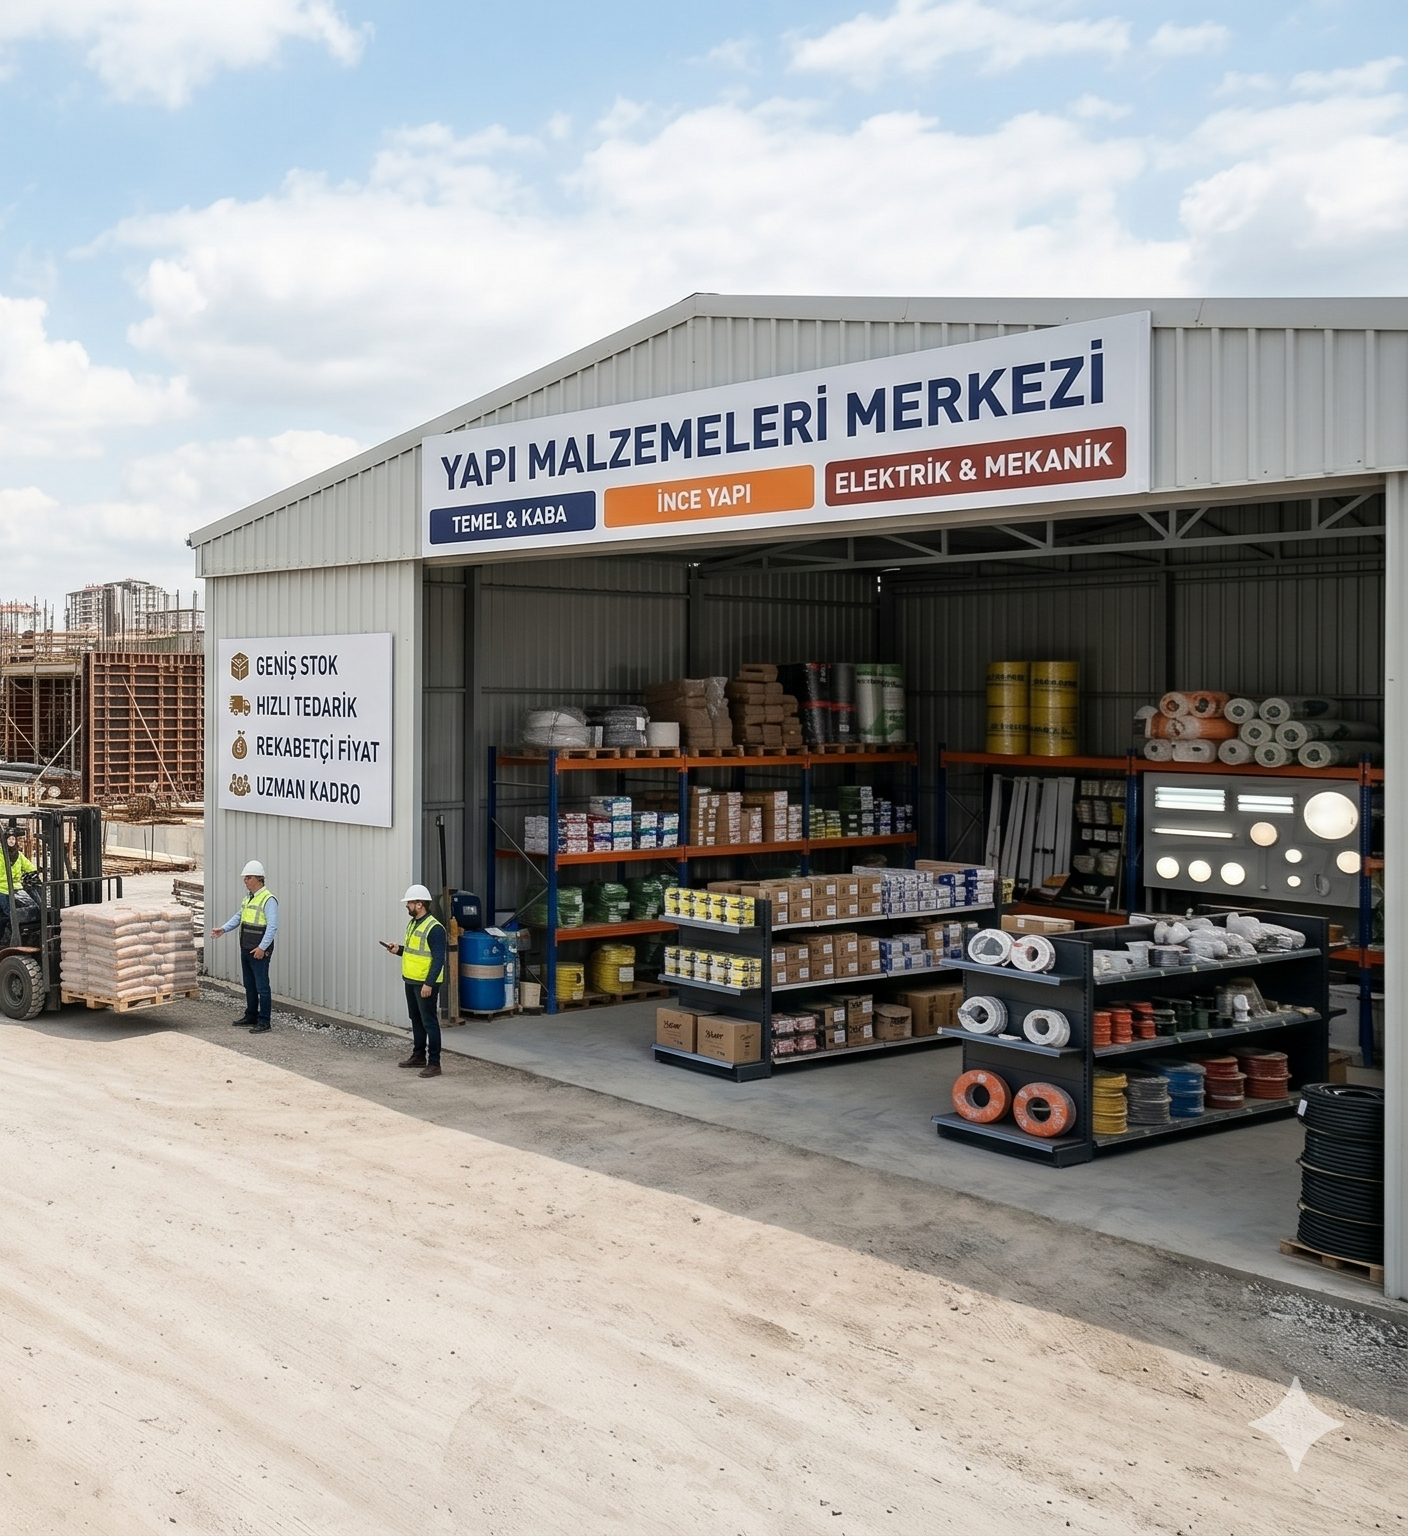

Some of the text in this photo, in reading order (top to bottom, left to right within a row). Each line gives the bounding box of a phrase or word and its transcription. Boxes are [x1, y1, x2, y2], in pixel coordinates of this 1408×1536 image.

[441, 339, 1104, 491] YAPI MALZEMELERİ MERKEZİ
[834, 438, 1114, 495] ELEKTRİK & MEKANİK
[657, 484, 752, 513] İNCE YAPI
[452, 505, 567, 533] TEMEL & KABA
[256, 651, 338, 680] GENİŞ STOK
[256, 691, 357, 718] HIZLI TEDARİK
[256, 734, 380, 764] REKABETÇİ FİYAT
[256, 776, 361, 805] UZMAN KADRO
